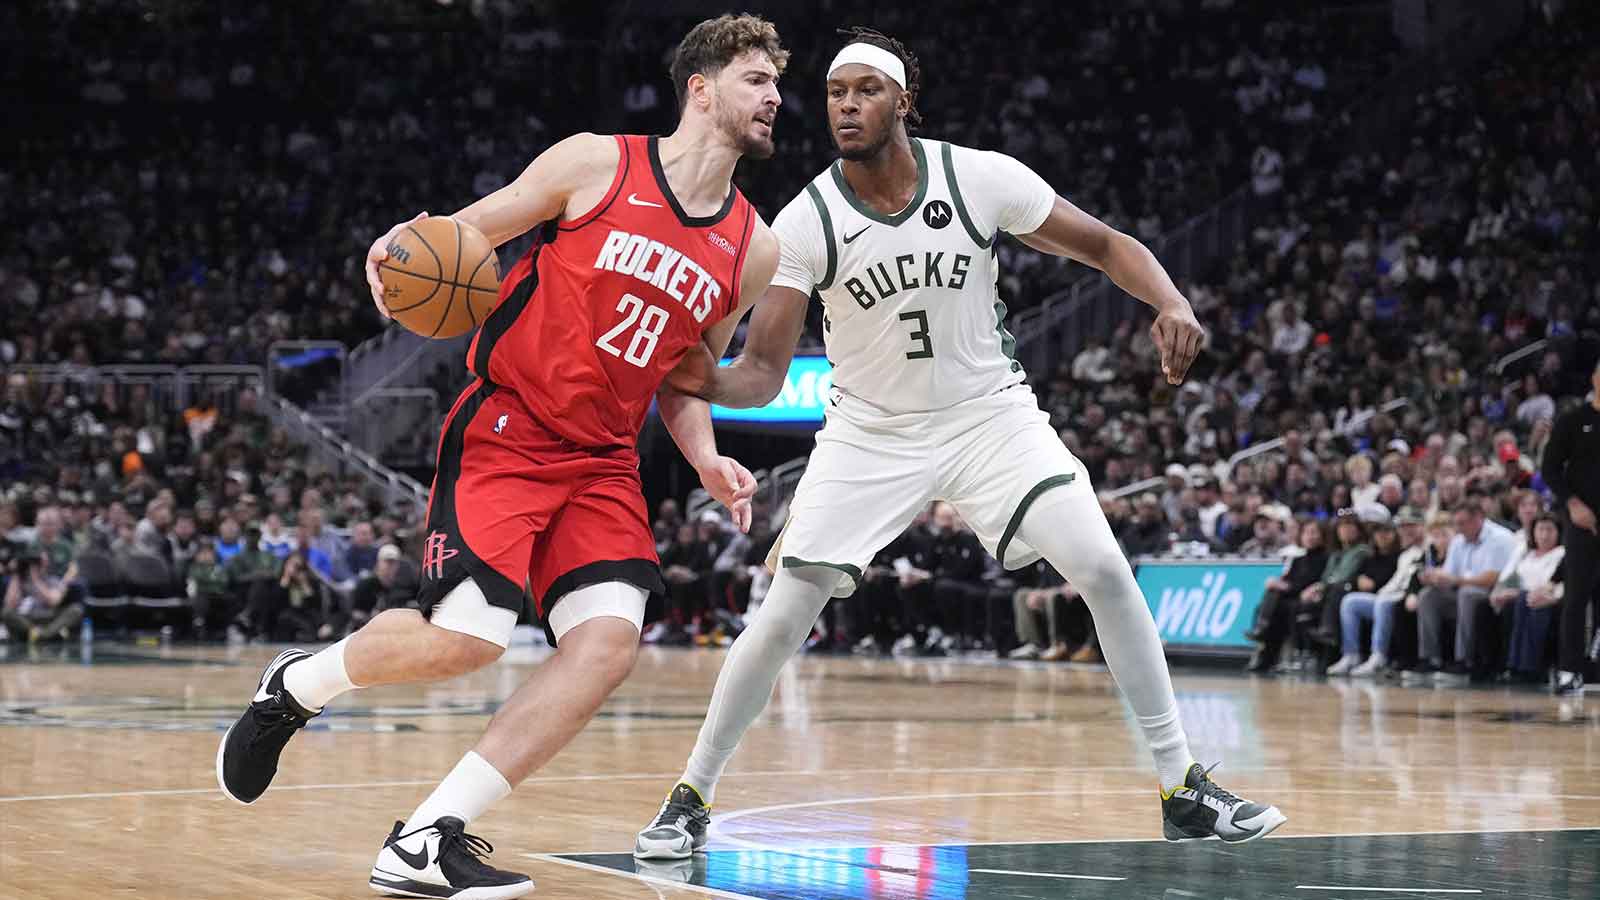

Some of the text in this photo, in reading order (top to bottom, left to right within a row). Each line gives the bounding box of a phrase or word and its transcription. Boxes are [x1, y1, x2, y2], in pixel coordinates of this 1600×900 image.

[386, 242, 410, 264] on
[593, 230, 721, 323] ROCKETS
[844, 251, 971, 310] BUCKS
[595, 293, 670, 368] 28
[899, 309, 934, 360] 3
[1155, 571, 1243, 638] wilo
